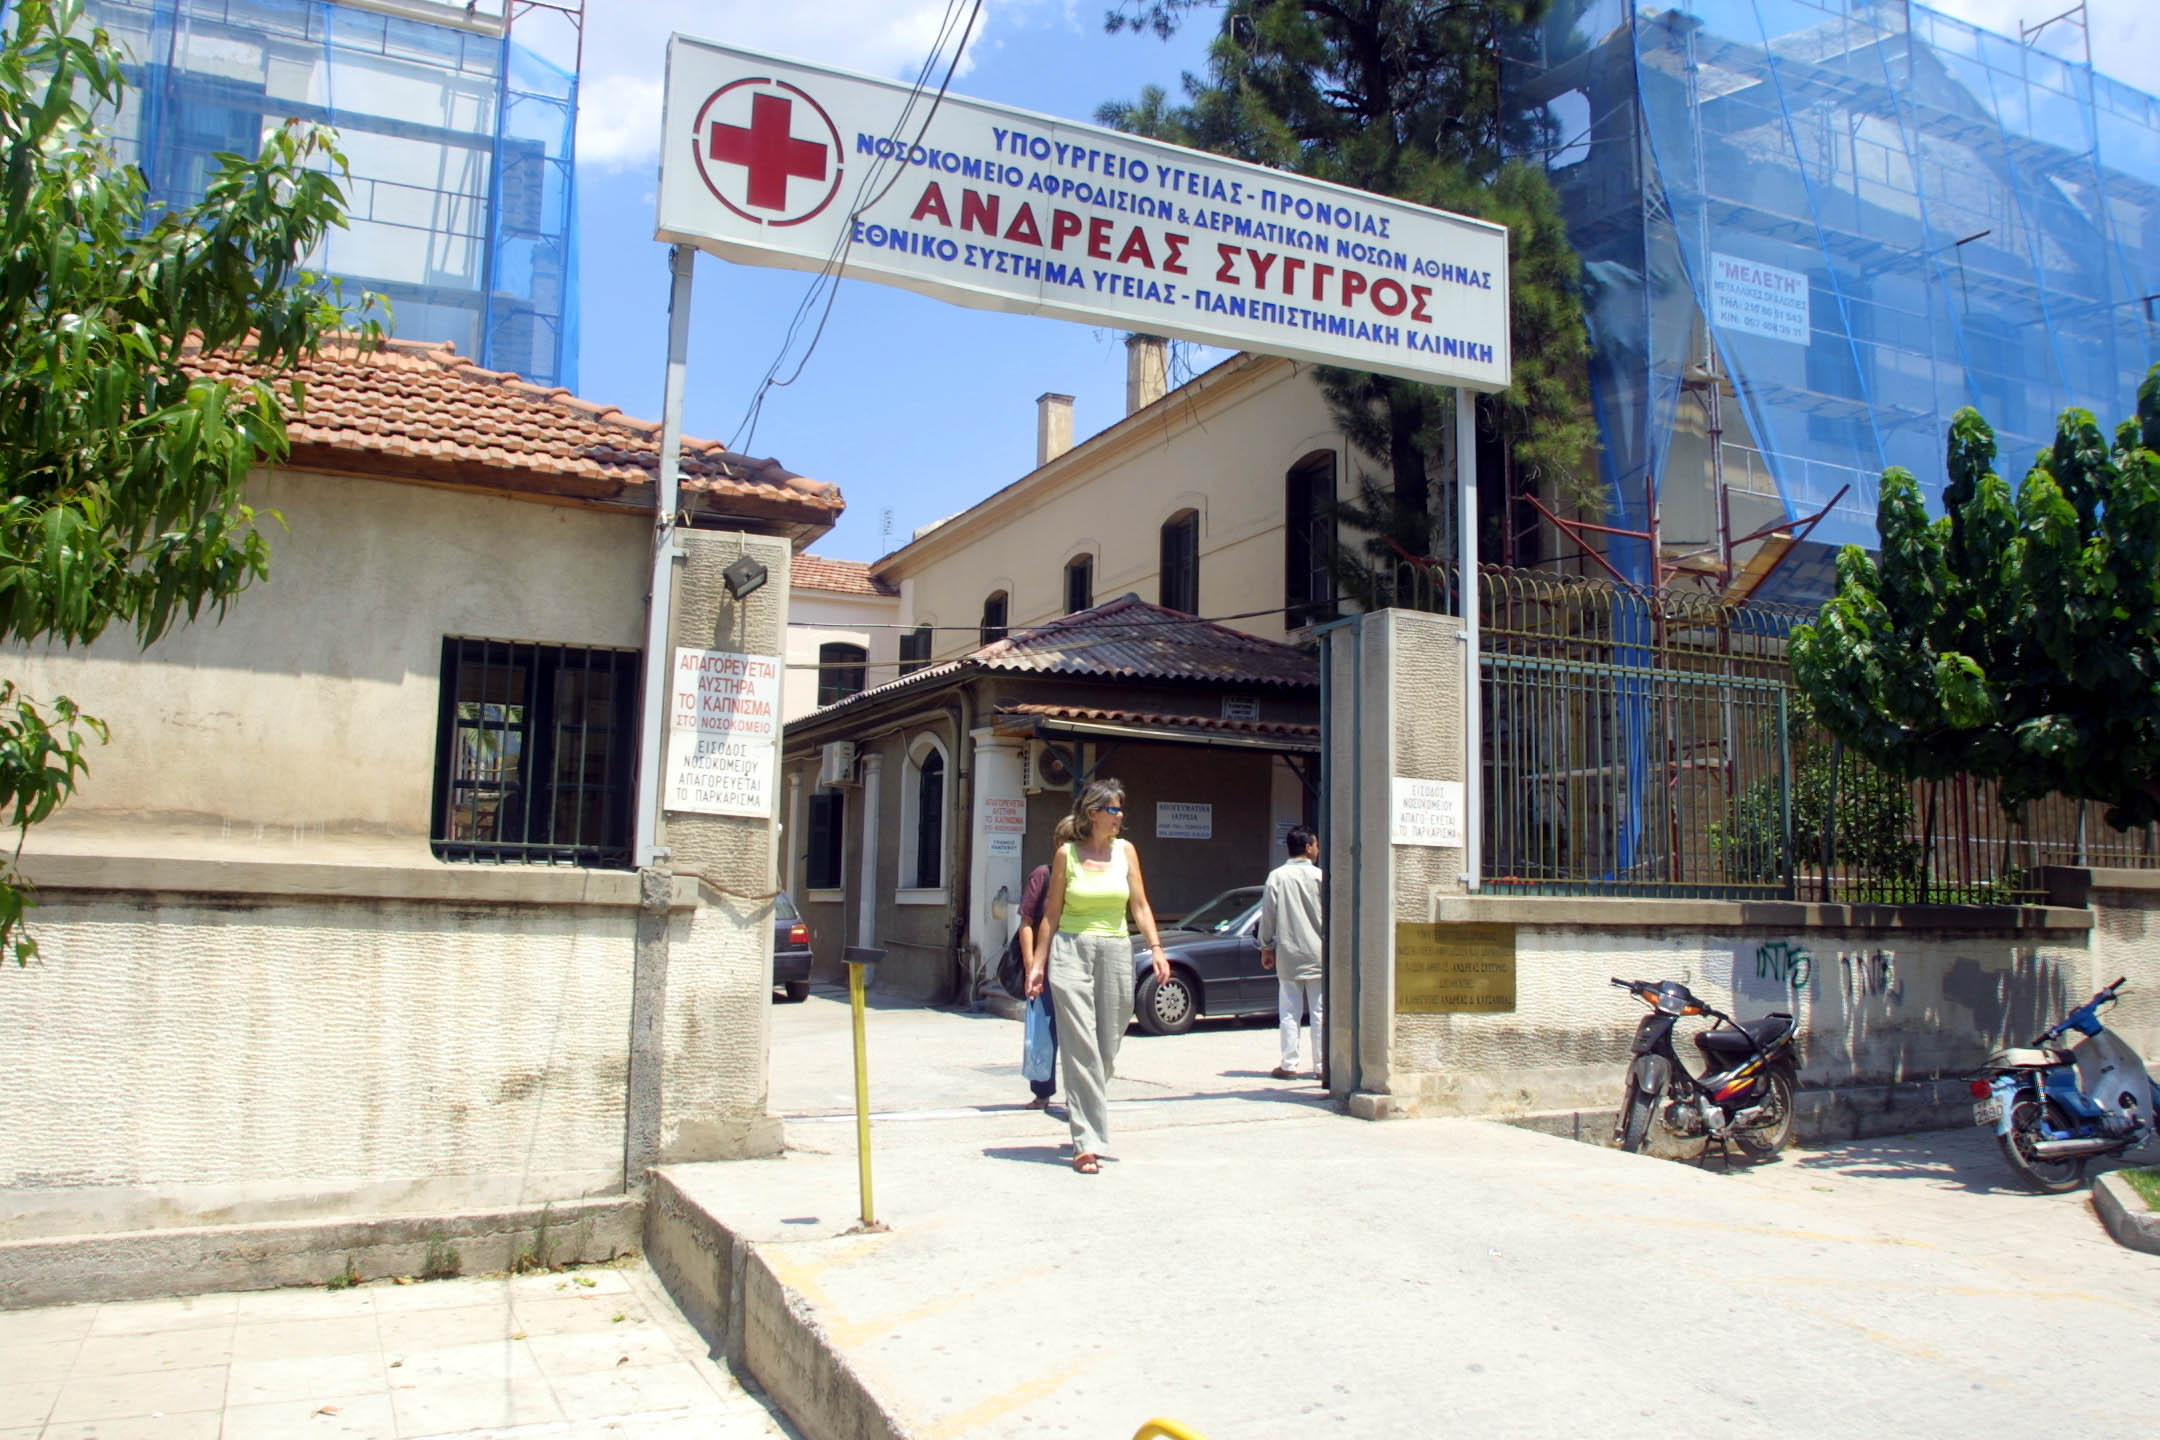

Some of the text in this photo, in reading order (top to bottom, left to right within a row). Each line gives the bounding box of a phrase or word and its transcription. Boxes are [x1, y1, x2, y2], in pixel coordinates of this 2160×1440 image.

[992, 127, 1149, 183] ΥΠΟΥΡΓΕΙΟ
[1157, 165, 1242, 205] ΥΓΕΙΑΣ
[1261, 189, 1390, 239] ΠΡΟΝΟΙΑΣ
[856, 133, 1491, 290] ΝΟΣΟΚΟΜΕΙΟ ΑΦΡΟΔΙΣΙΩΝ & ΔΕΡΜΑΤΙΚΩΝ ΝΟΣΩΝ ΑΘΗΝΑΣ
[910, 181, 1433, 323] ΑΝΔΡΕΑΣ ΣΥΓΓΡΟΣ
[851, 220, 959, 262] ΕΘΝΙΚΟ
[964, 244, 1085, 289] ΣΥΣΤΗΜΑ
[1093, 270, 1176, 305] ΥΓΕΙΑΣ
[1195, 290, 1399, 346] ΠΑΝΕΠΙΣΤΗΜΙΑΚΗ
[1407, 330, 1493, 364] ΚΛΙΝΙΚΗ
[680, 655, 775, 678] ΑΠΑΓΟΡΕΥΕΤΑΙ
[699, 677, 755, 696] ΑΥΣΤΗΡΑ
[679, 693, 771, 716] ΤΟ ΚΑΠΝΙΣΜΑ
[676, 715, 771, 733] ΣΤΟ ΝΟΣΟΚΟΜΕΙΟ
[698, 740, 747, 757] ΕΙΣΟΔΟΣ
[684, 756, 758, 774] ΝΟΣΟΚΟΜΕΙΟΥ
[679, 773, 761, 791] ΑΠΑΓΟΡΕΥΕΤΑΙ
[676, 788, 761, 807] ΤΟ ΠΑΡΚΑΡΙΣΜΑ
